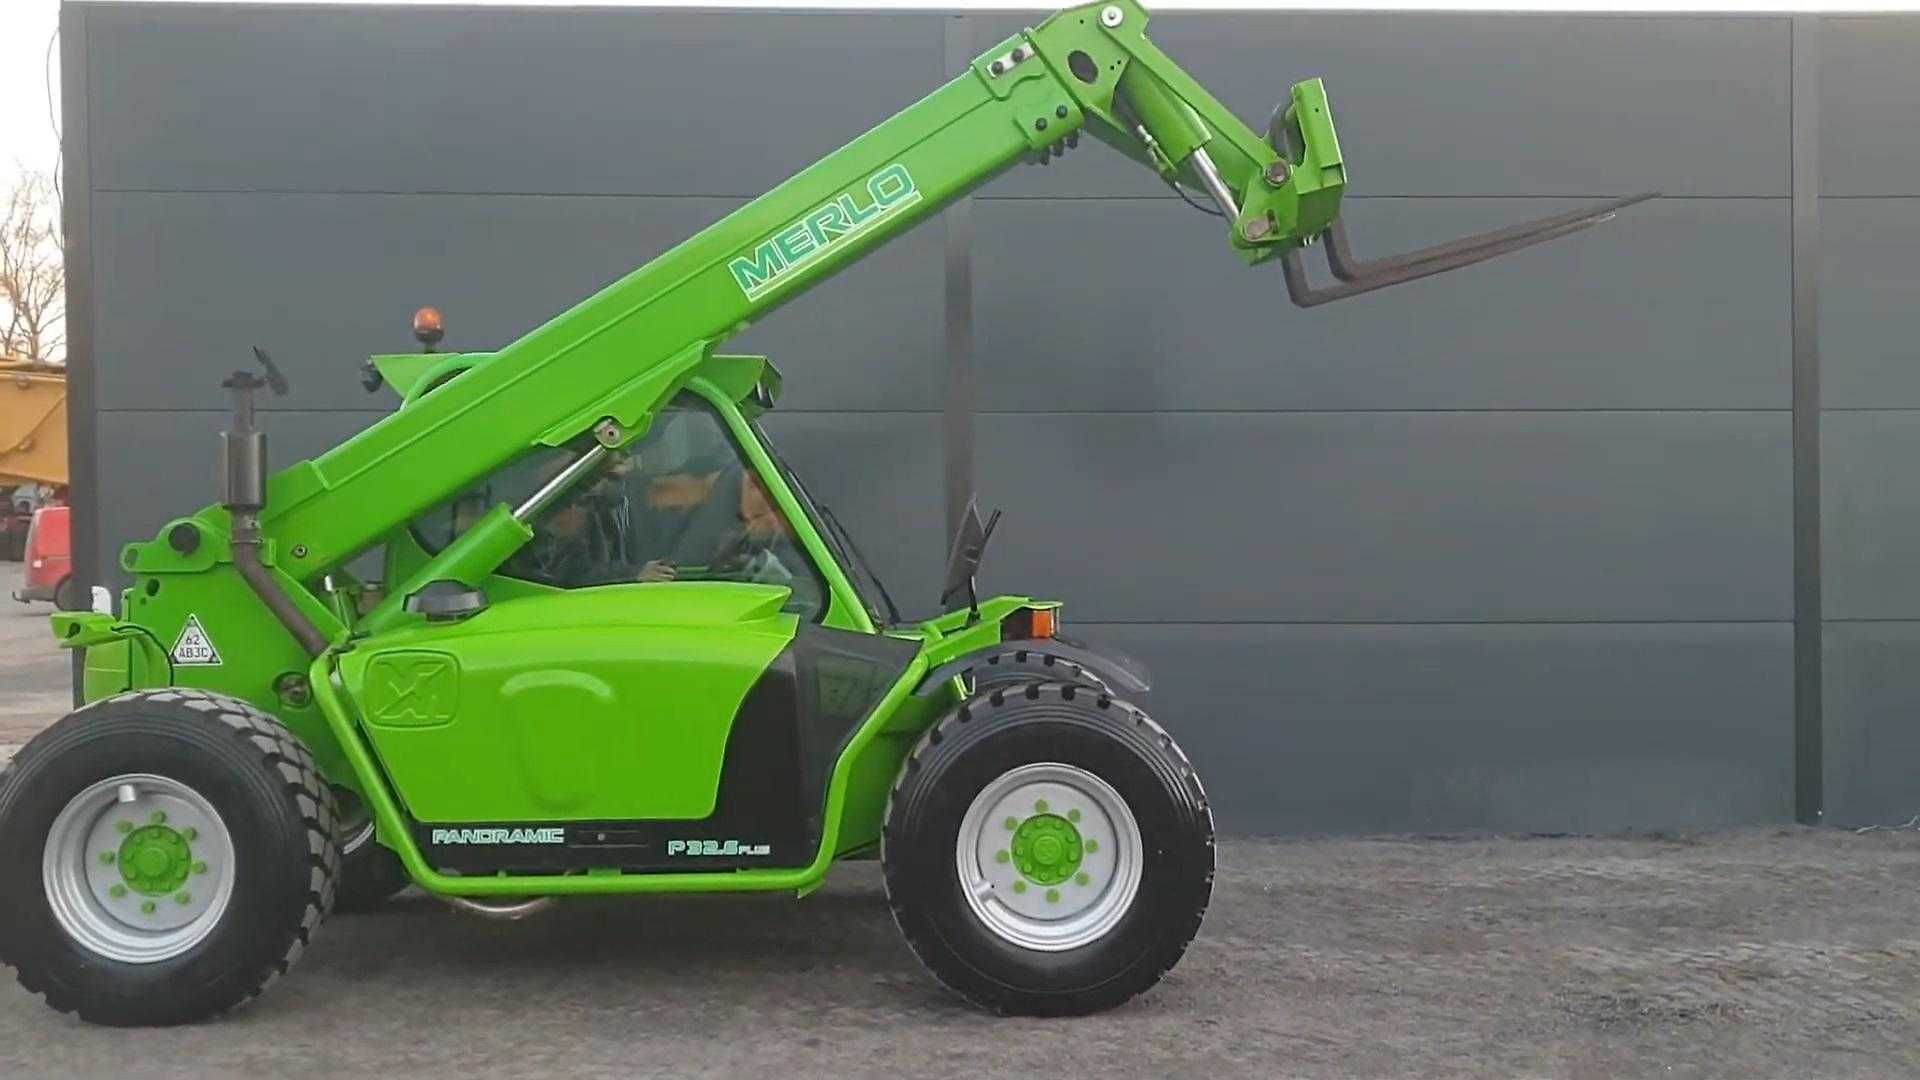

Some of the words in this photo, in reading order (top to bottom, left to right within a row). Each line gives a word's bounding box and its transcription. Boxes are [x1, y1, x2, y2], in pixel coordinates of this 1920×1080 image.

[728, 163, 916, 295] MERLO
[185, 634, 200, 645] 62
[432, 828, 565, 844] PANORAMIC
